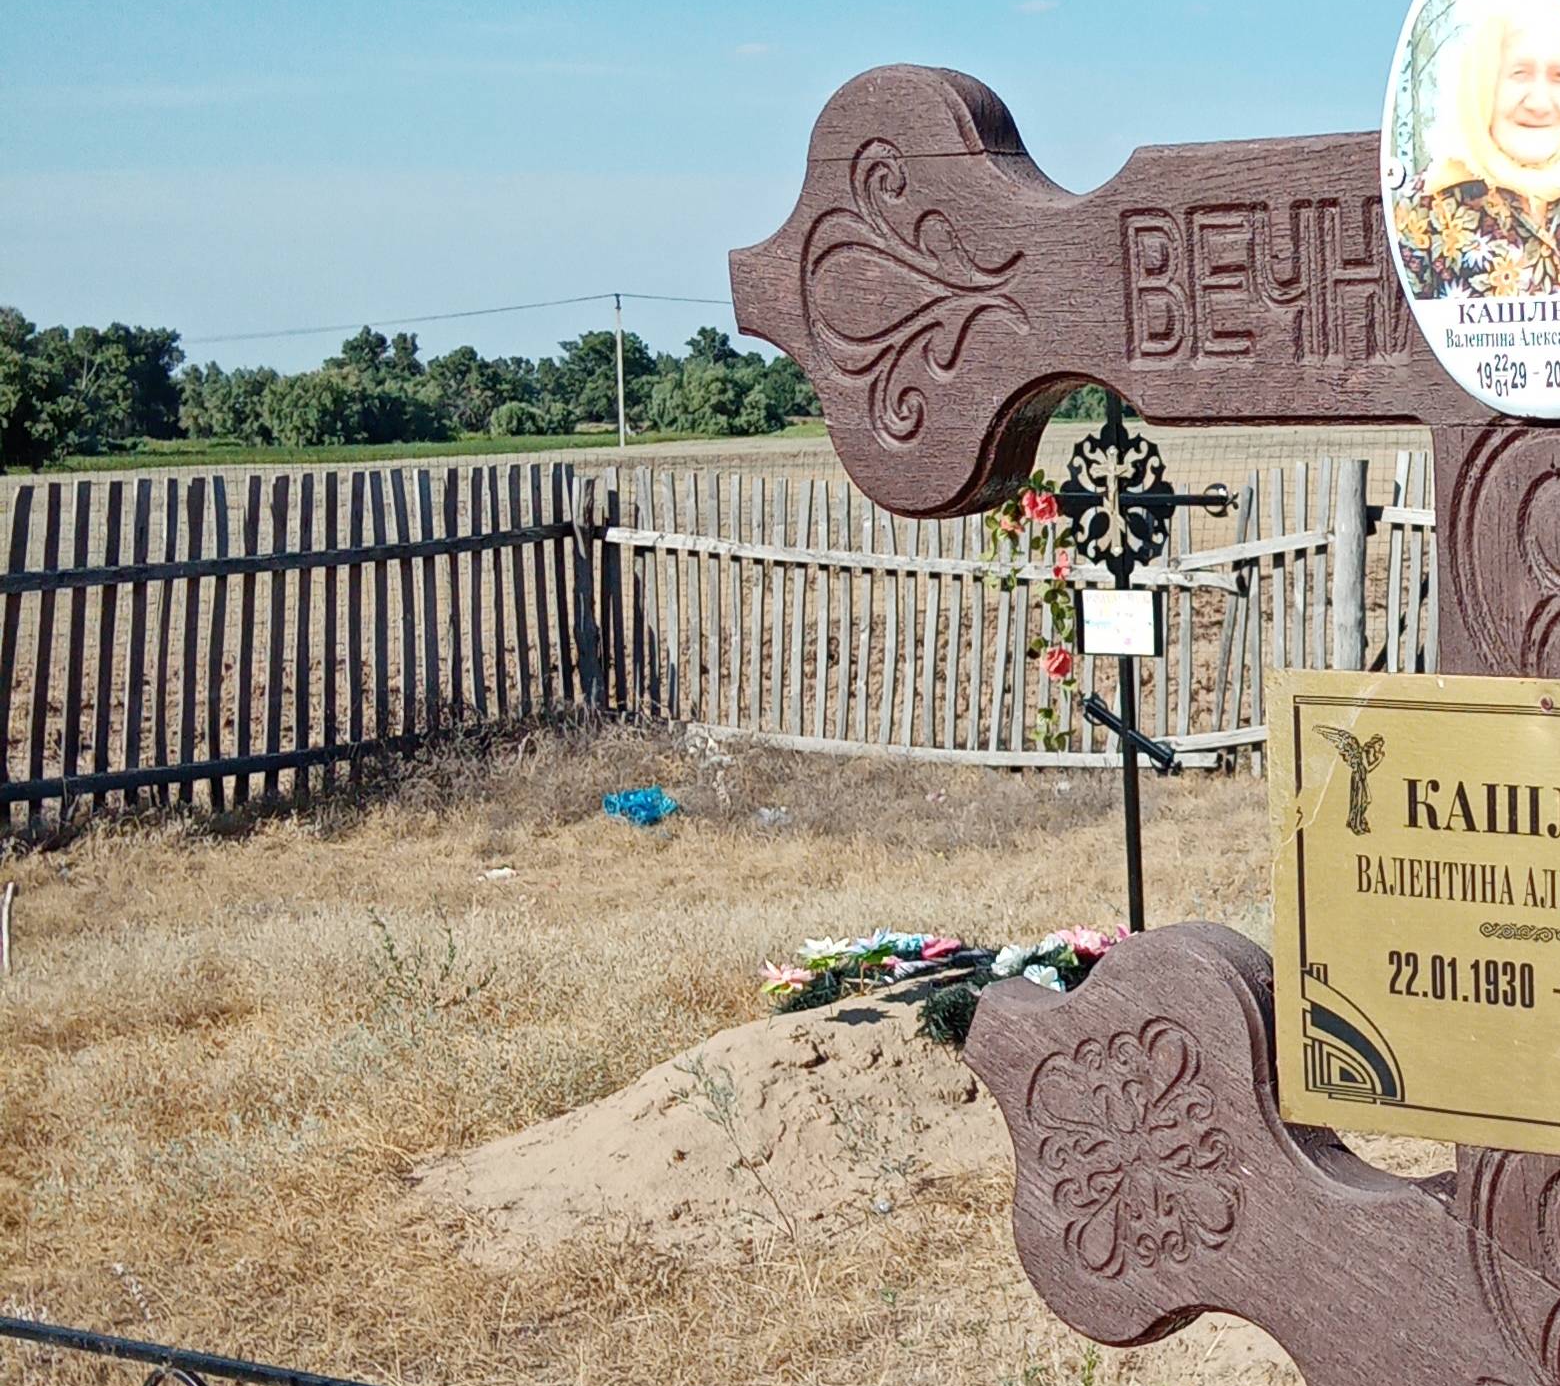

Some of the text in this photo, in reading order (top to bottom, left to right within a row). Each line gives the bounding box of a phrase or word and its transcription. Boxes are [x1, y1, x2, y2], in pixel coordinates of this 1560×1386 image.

[1119, 197, 1411, 363] ВЕЧН
[1446, 328, 1515, 349] Валентина
[1355, 854, 1514, 906] ВАЛЕНТИНА
[1388, 950, 1535, 1009] 22.01.1930
